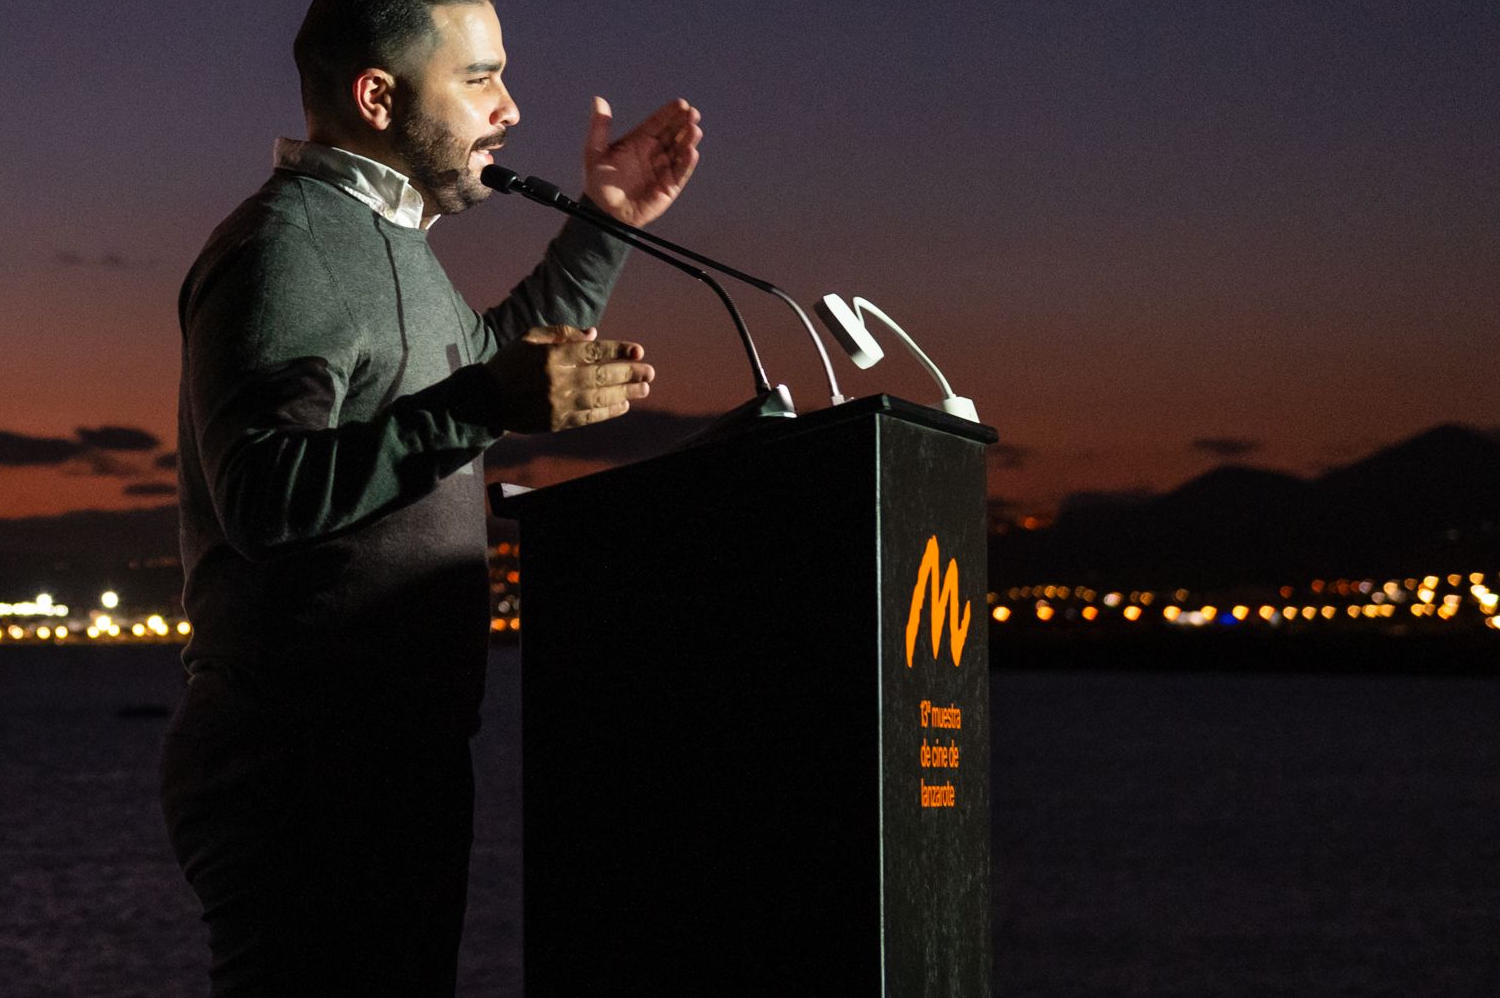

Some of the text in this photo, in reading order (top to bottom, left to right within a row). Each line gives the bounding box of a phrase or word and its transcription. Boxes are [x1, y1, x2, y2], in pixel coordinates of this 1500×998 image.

[931, 703, 962, 730] muestra
[920, 737, 959, 768] de cine de
[920, 777, 956, 808] lanzarote
